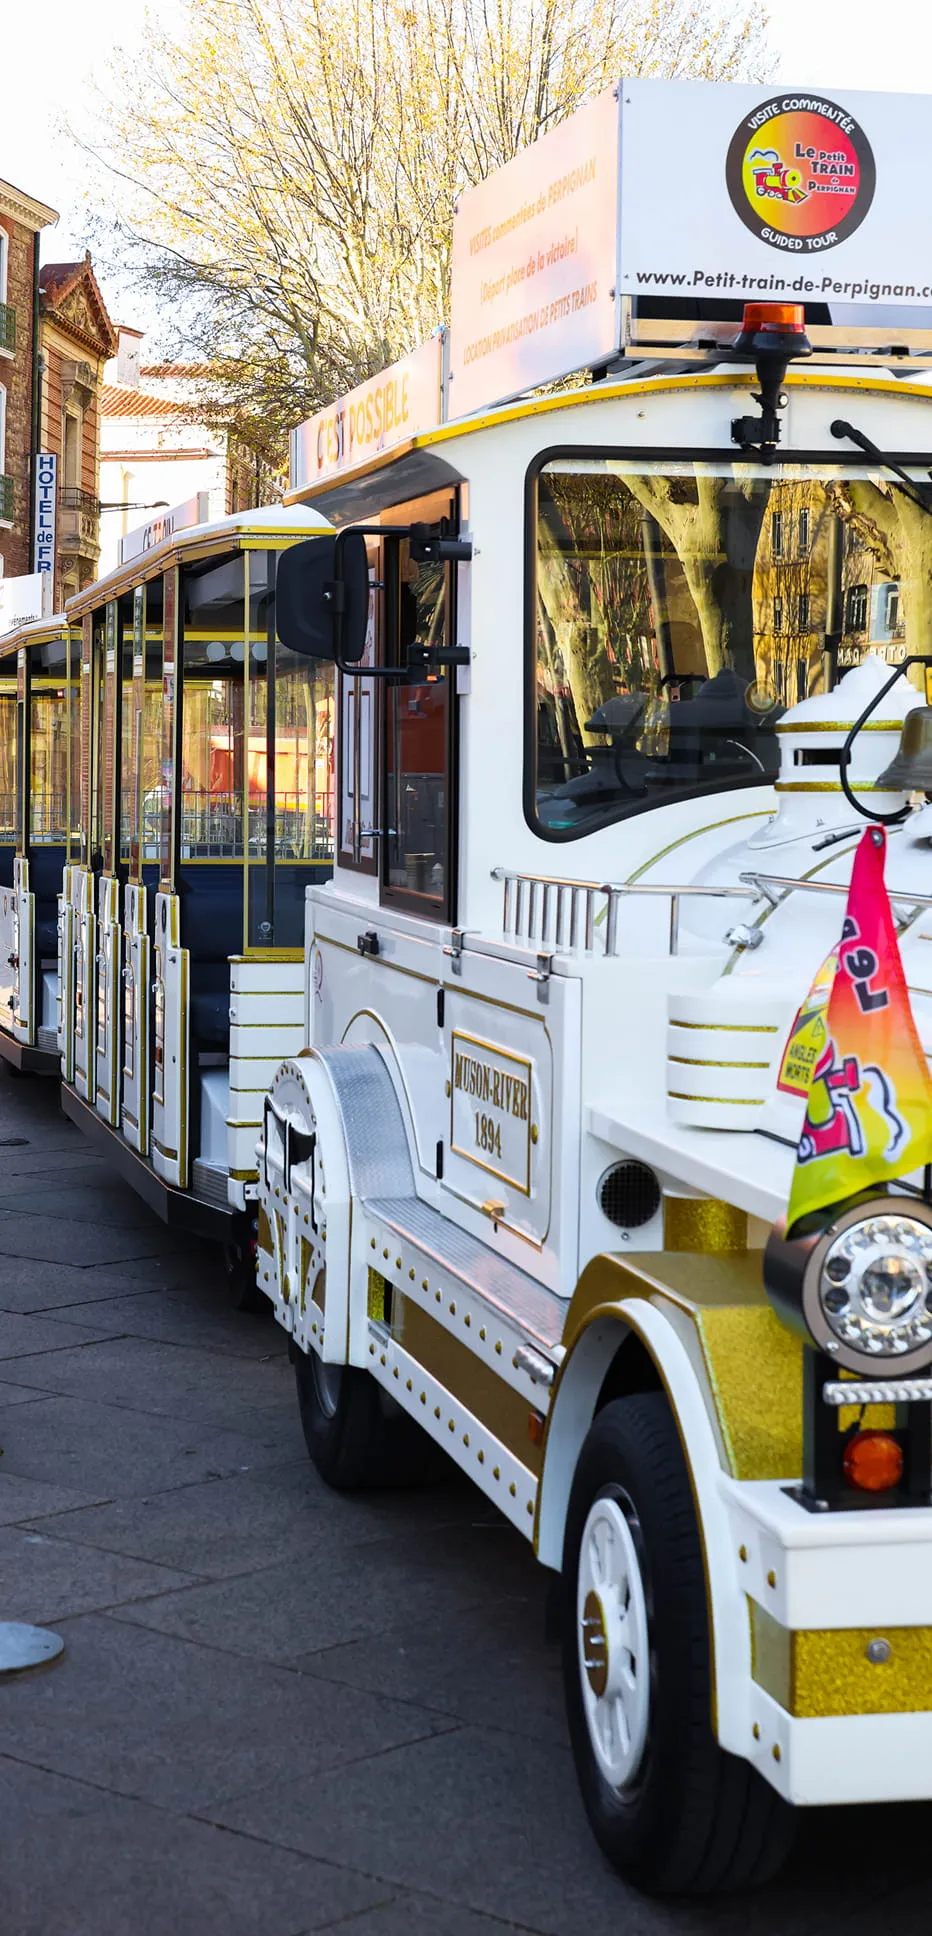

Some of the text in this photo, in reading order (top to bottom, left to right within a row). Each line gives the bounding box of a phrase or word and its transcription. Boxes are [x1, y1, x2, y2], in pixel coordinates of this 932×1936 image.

[747, 99, 856, 134] VISITE COMMENTÉE
[795, 143, 816, 158] Le
[811, 161, 854, 175] TRAIN
[469, 225, 492, 256] VISITES
[537, 192, 547, 213] de
[547, 157, 597, 208] PERPIGNAN
[760, 228, 838, 250] GUIDED TOUR
[506, 263, 526, 296] place
[526, 255, 536, 278] de
[537, 249, 545, 271] la
[463, 280, 598, 366] LOCATION PRIVATISATION DE PETITS TRAINS
[317, 373, 409, 470] C'EST POSSIBLE
[38, 456, 54, 528] HOTEL
[36, 530, 53, 543] de
[475, 1111, 502, 1159] 1894
